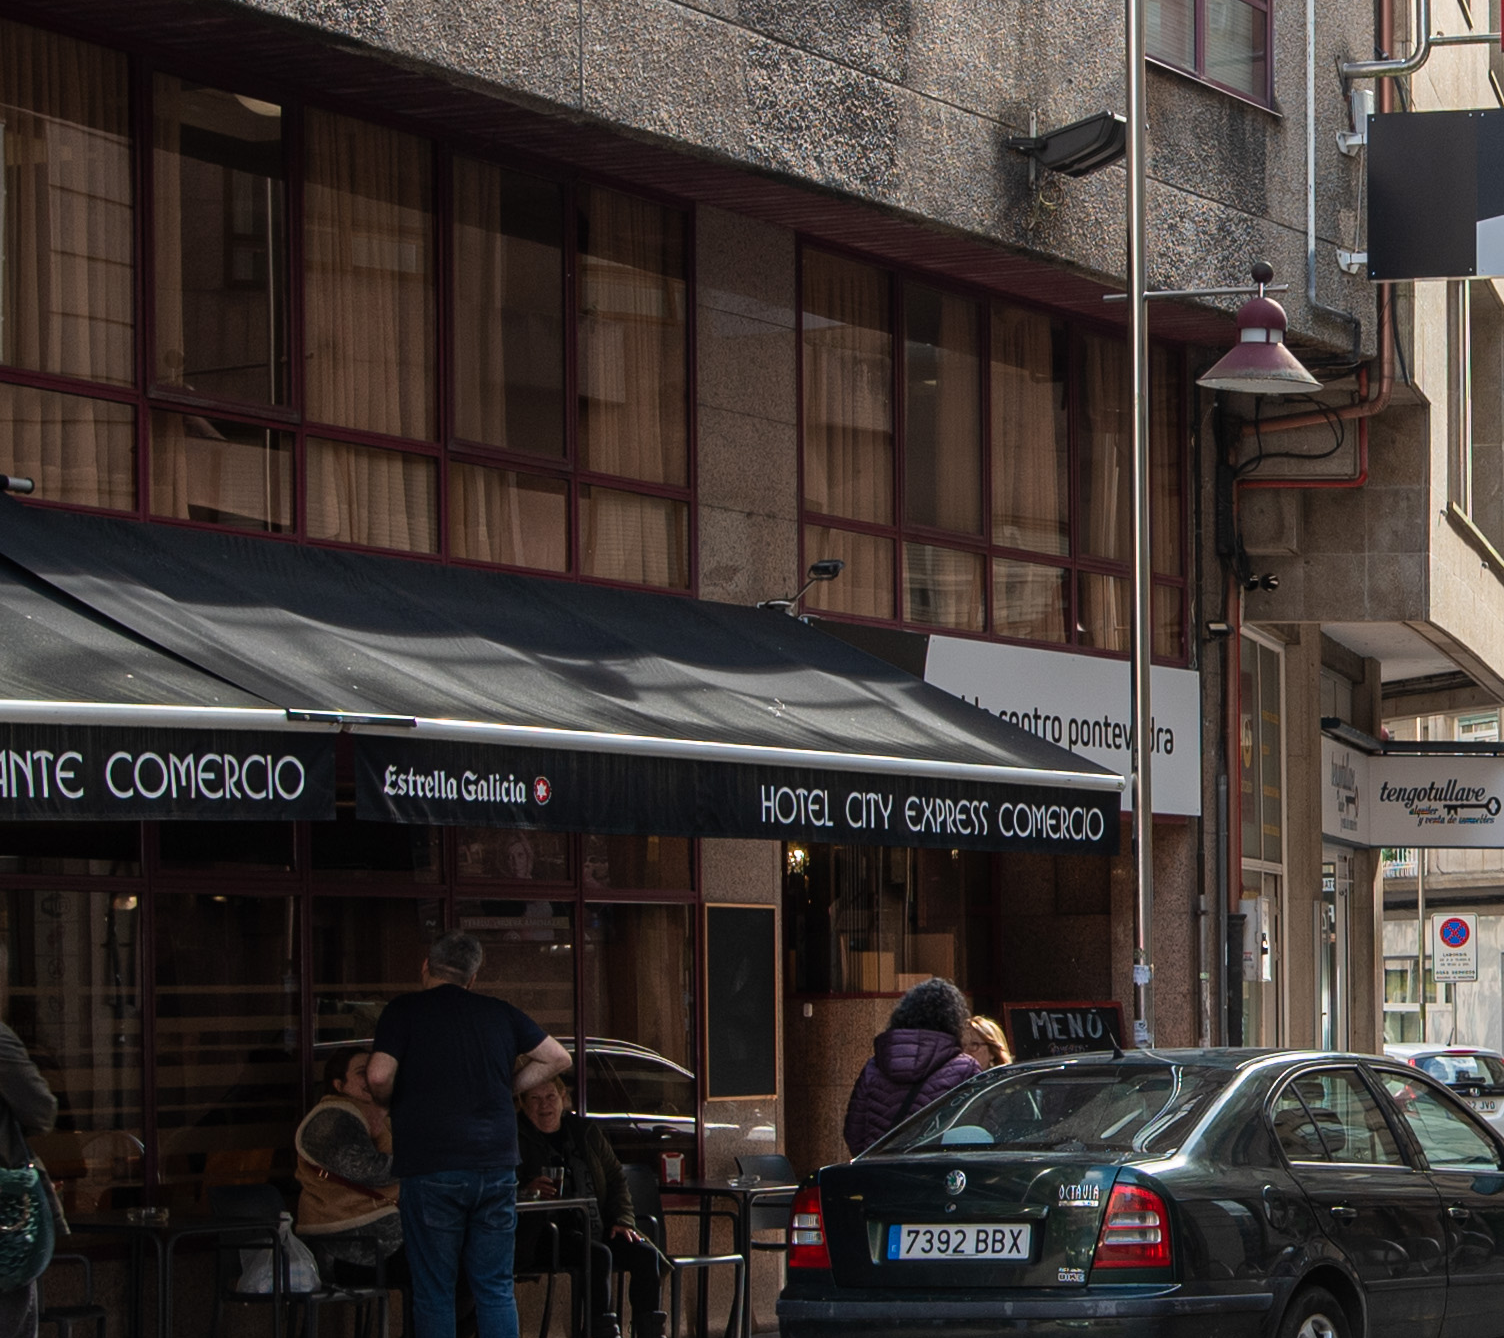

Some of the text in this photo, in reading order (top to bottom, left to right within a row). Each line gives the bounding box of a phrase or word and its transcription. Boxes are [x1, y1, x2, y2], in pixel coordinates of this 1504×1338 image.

[1069, 715, 1174, 756] pontevdra
[105, 750, 306, 801] COMERCIO
[383, 764, 458, 801] Estrella
[461, 769, 527, 804] Galicia
[1379, 778, 1486, 808] tengotullave
[761, 785, 1104, 841] HOTEL CITY EXPRESS COMERCIO
[1058, 1184, 1100, 1200] OCTAVIA
[905, 1228, 1023, 1254] 7392 BBX
